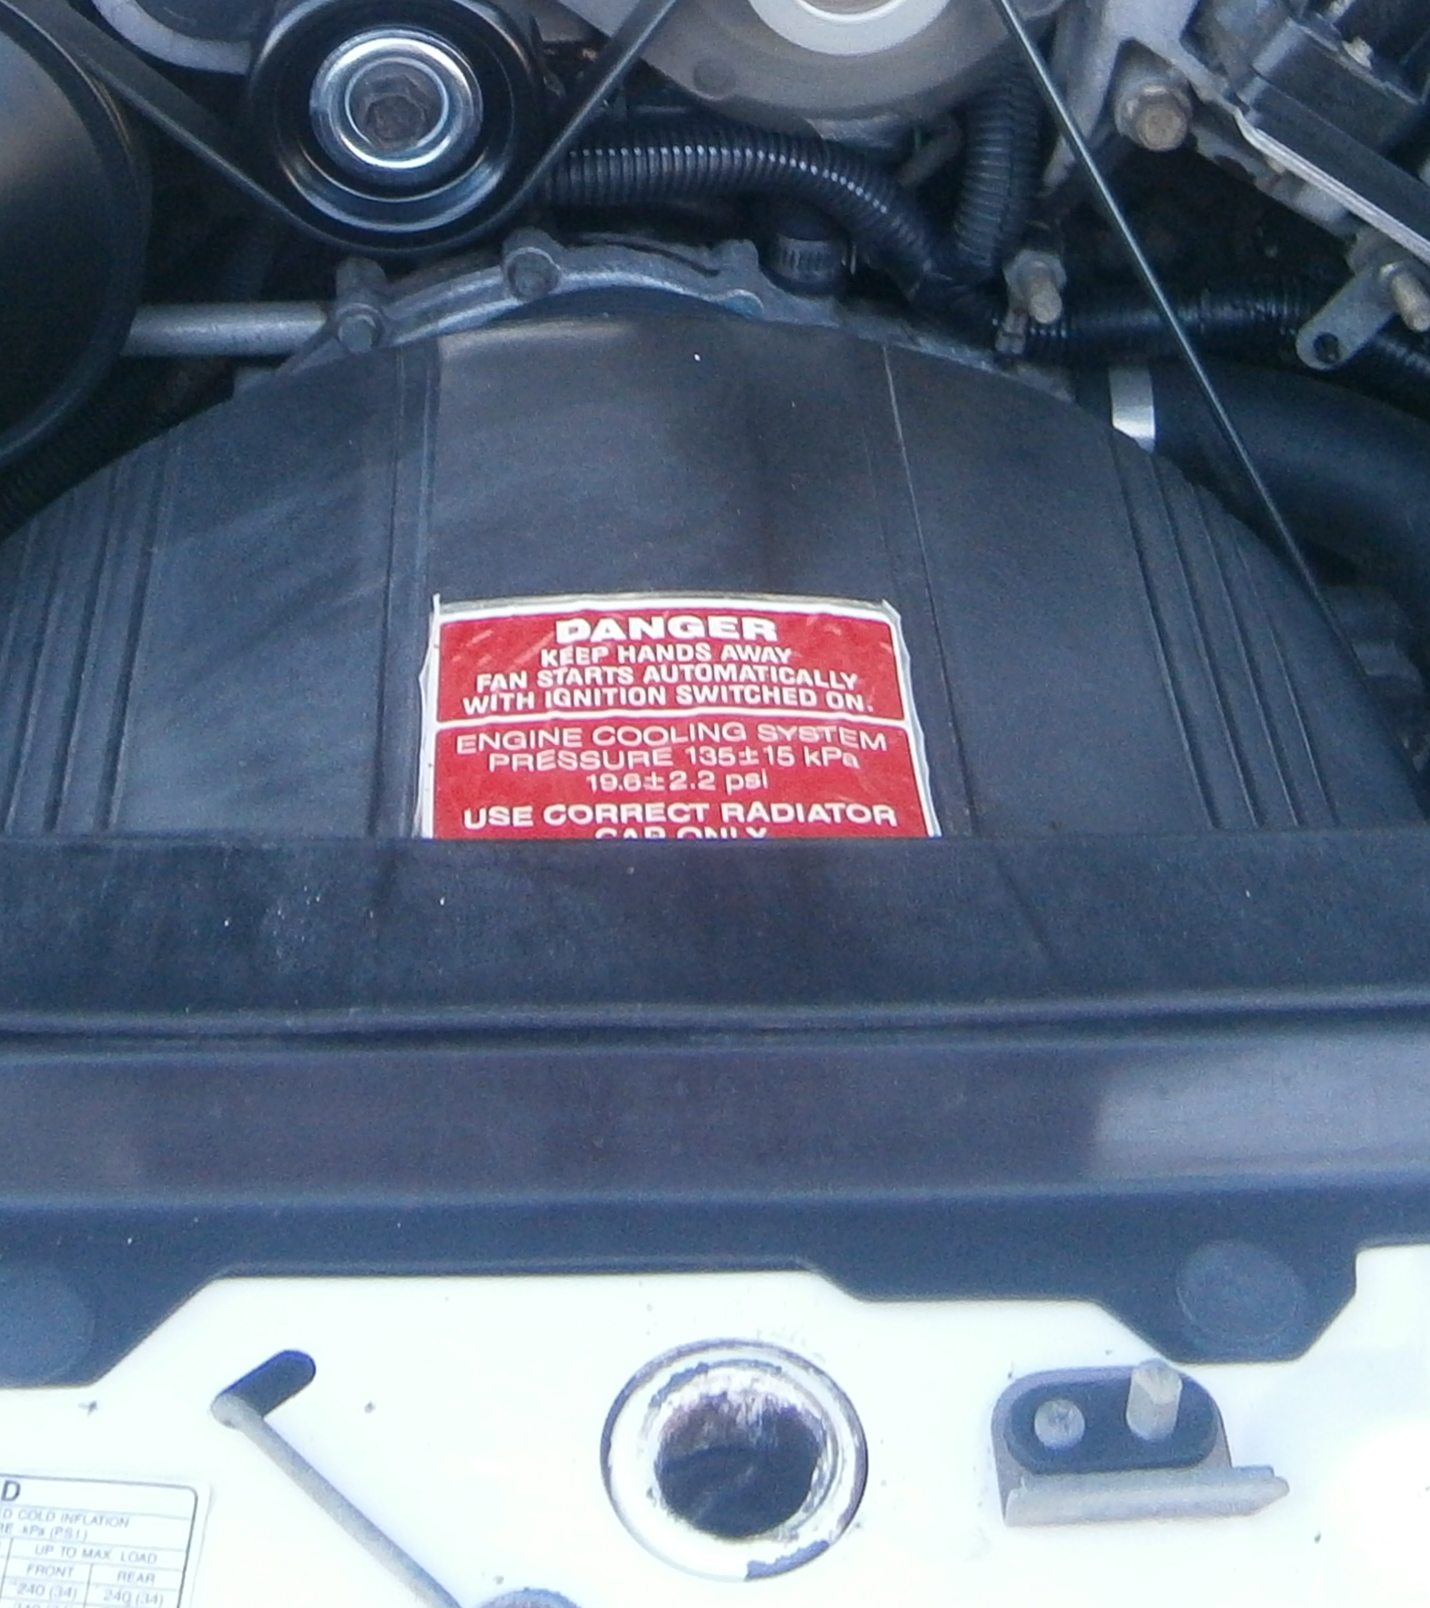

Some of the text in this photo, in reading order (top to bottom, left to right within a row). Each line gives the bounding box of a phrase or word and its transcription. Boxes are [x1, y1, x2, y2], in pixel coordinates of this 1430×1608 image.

[555, 616, 777, 643] DANGER
[540, 643, 792, 667] KEEP HANDS AWAY
[476, 664, 858, 691] FAN STARTS AUTOMATICALLY
[463, 685, 874, 714] WITH IGNITION SWITCHED ON.
[457, 723, 886, 754] ENGINE COOLING SYSTEM
[488, 749, 673, 771] PRESSURE
[804, 746, 859, 769] kPa
[725, 768, 768, 794] psi
[463, 802, 897, 828] USE CORRECT RADIATOR
[18, 1510, 57, 1524] COLD
[60, 1512, 130, 1529] INFLATION
[34, 1543, 56, 1557] UP
[59, 1545, 78, 1559] TO
[119, 1550, 158, 1565] LOAD
[25, 1562, 76, 1579] FRONT
